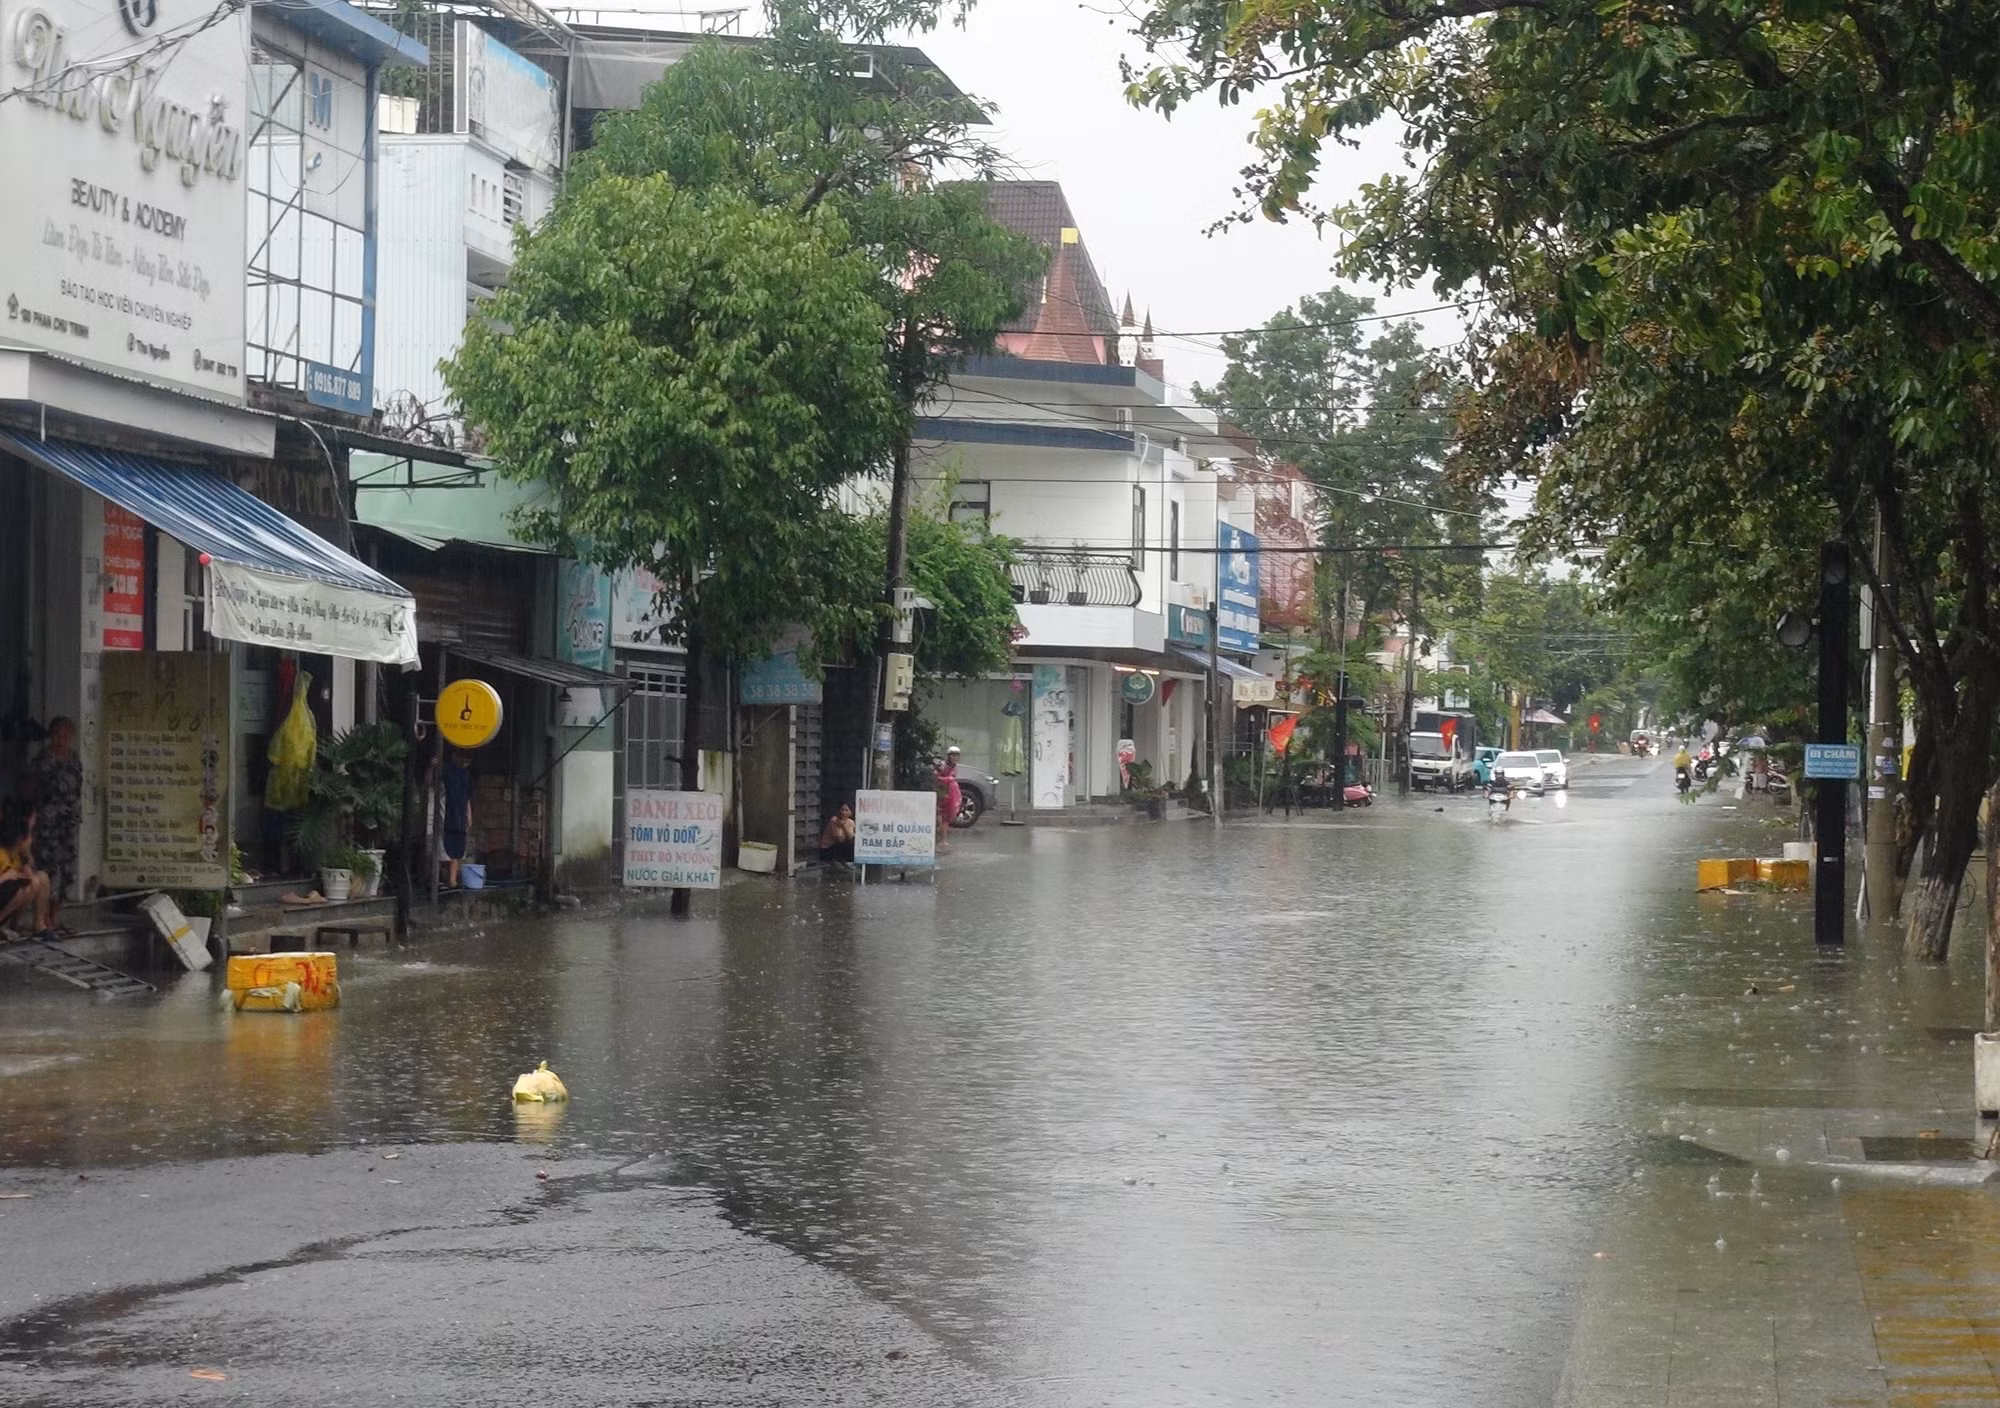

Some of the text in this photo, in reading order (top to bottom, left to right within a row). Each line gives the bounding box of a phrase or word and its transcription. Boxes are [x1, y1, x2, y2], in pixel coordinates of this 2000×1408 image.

[71, 177, 187, 241] BEAUTY & ACADEMY
[630, 823, 653, 842] TÔM
[861, 837, 883, 848] RAM
